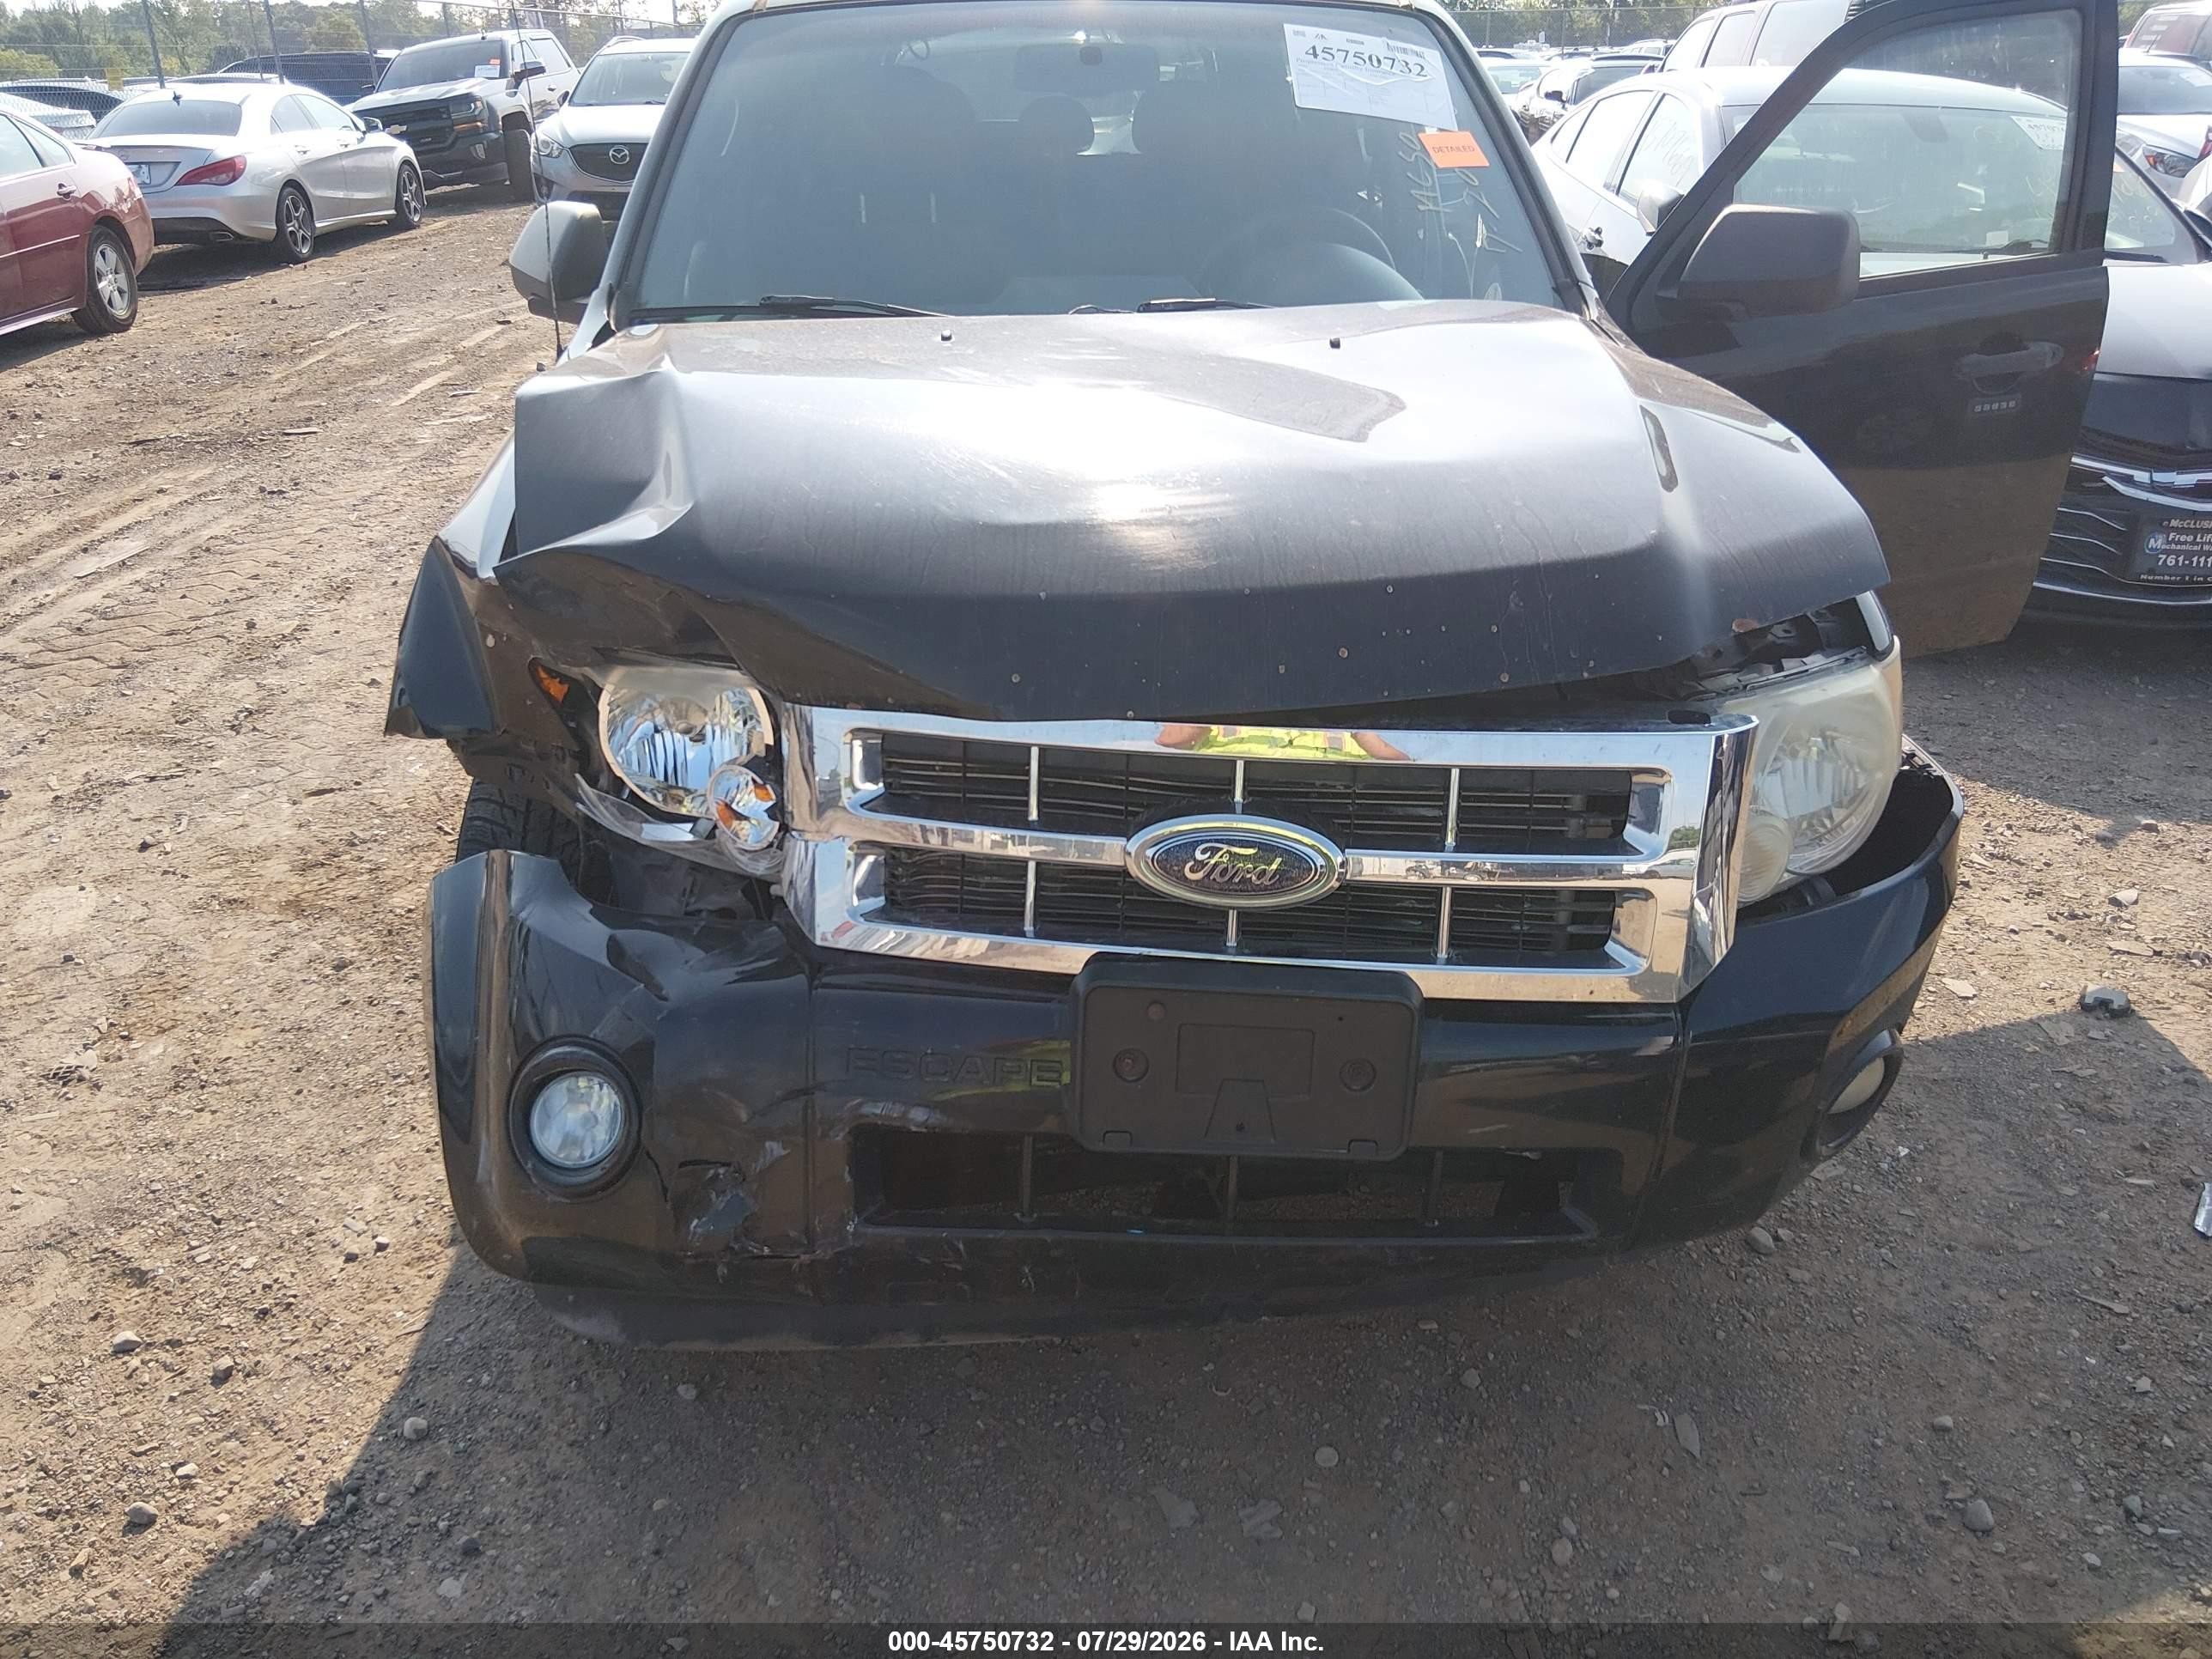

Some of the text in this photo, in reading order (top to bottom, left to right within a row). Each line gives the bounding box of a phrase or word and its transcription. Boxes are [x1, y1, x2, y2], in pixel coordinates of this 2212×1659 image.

[1304, 45, 1428, 77] 45750732
[1431, 144, 1476, 155] DETAILED
[2148, 538, 2201, 550] Mechanical
[2168, 532, 2212, 543] Free Lif
[2158, 554, 2212, 568] 761-111
[1184, 842, 1283, 885] Ford
[846, 1047, 1064, 1087] ESCAPE
